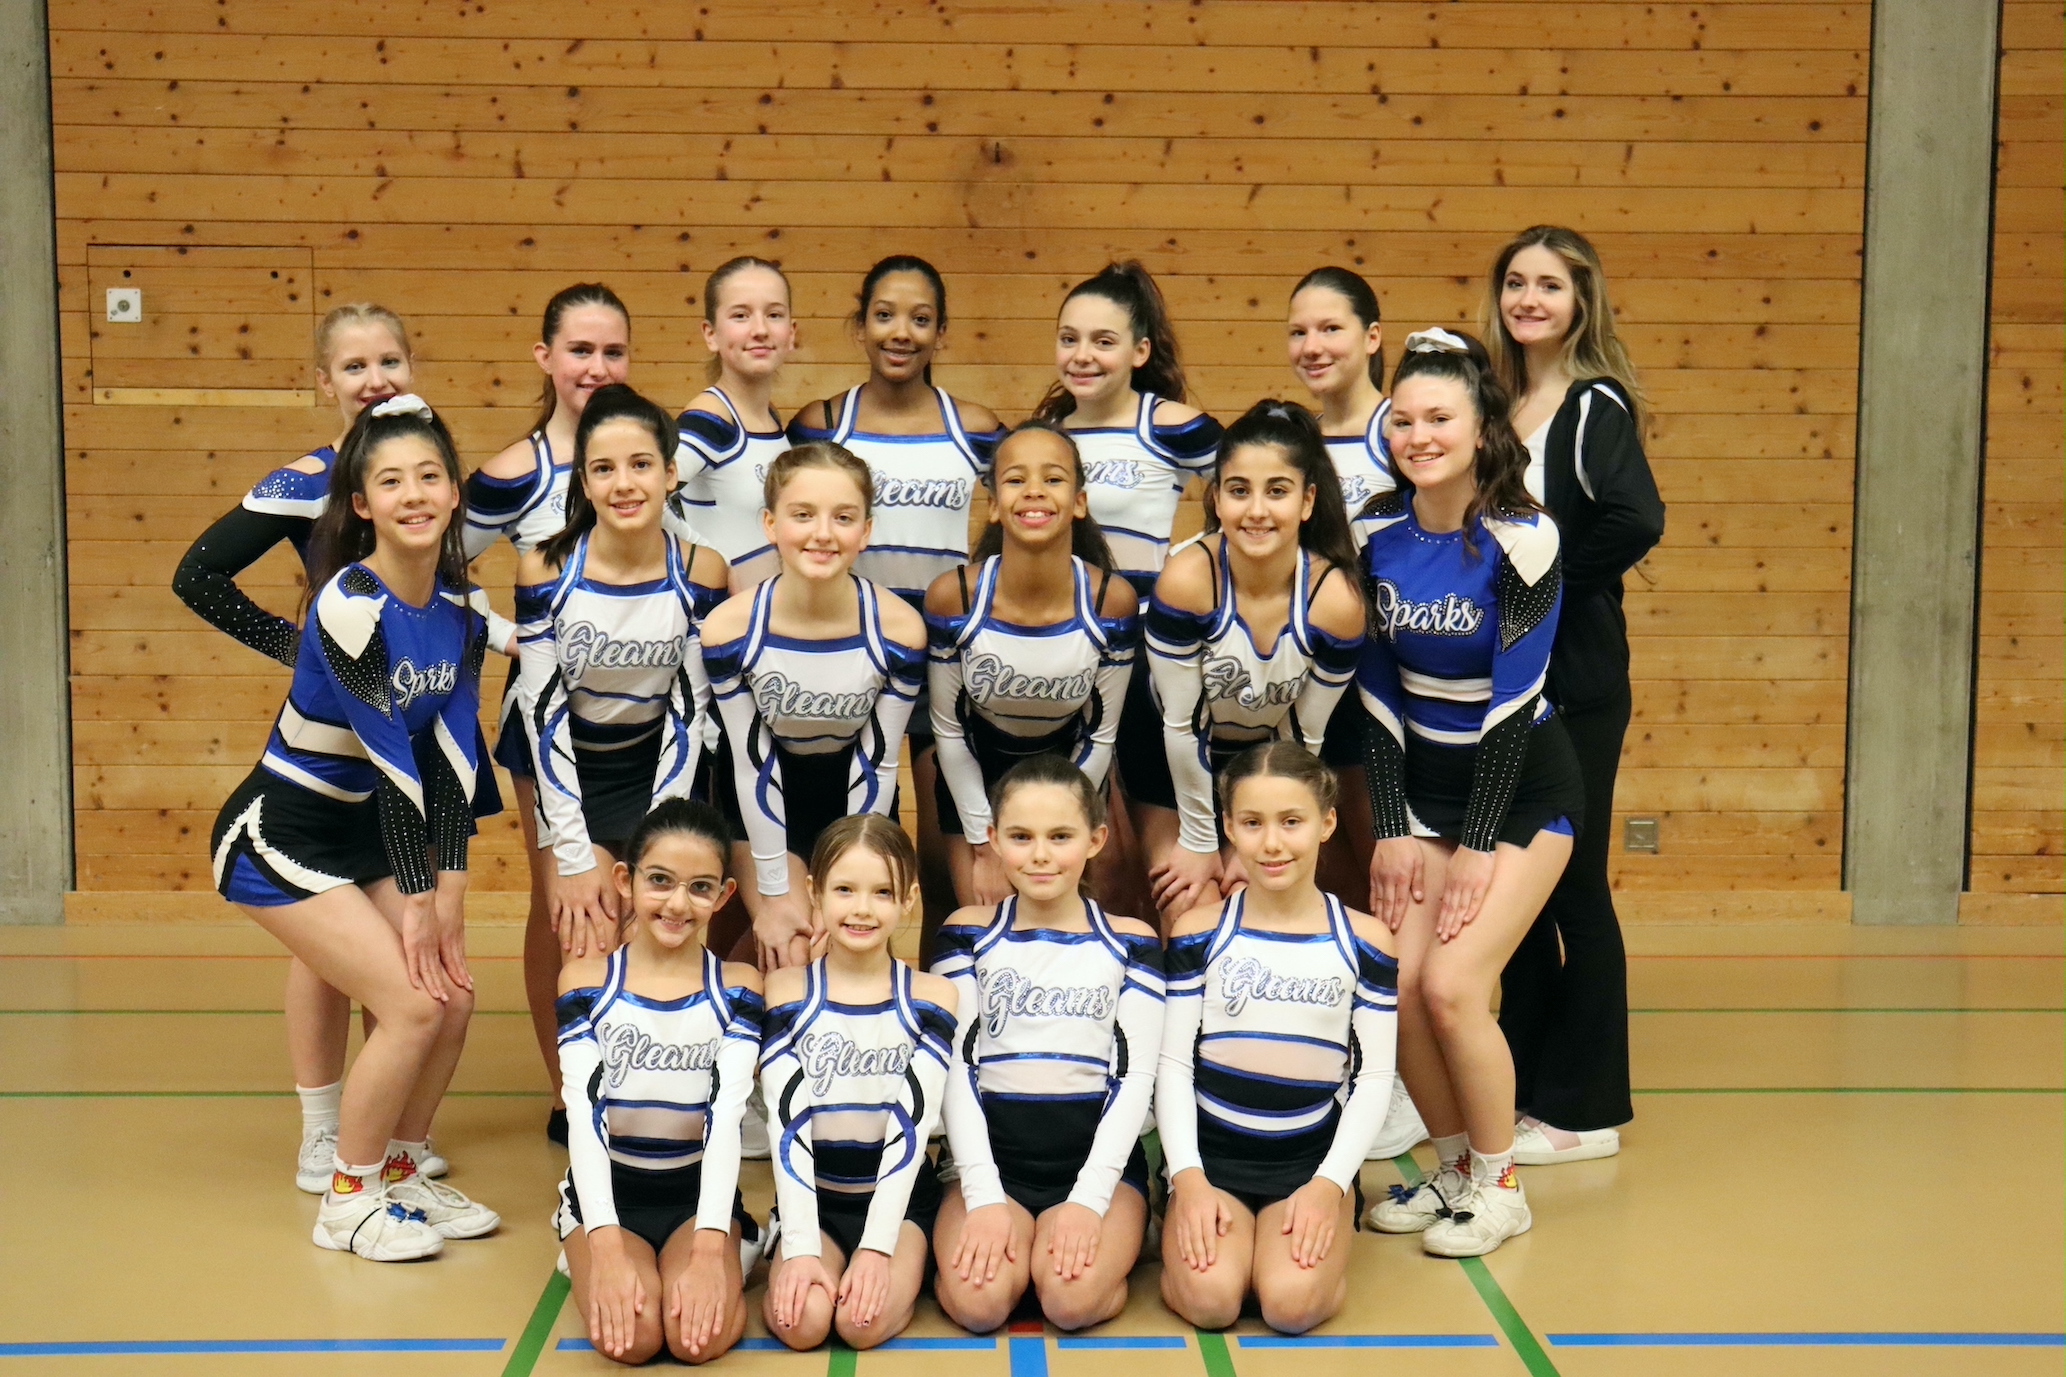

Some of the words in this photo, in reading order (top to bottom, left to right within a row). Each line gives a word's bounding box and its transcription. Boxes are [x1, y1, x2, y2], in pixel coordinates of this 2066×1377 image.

[872, 470, 970, 511] leams
[1376, 580, 1485, 643] Sparks
[556, 619, 686, 680] Gleams
[961, 648, 1097, 704] Gleams
[747, 670, 878, 726] Gleams
[976, 967, 1114, 1038] Gleams
[1218, 956, 1346, 1017] Gleams
[600, 1022, 721, 1089] Gleams
